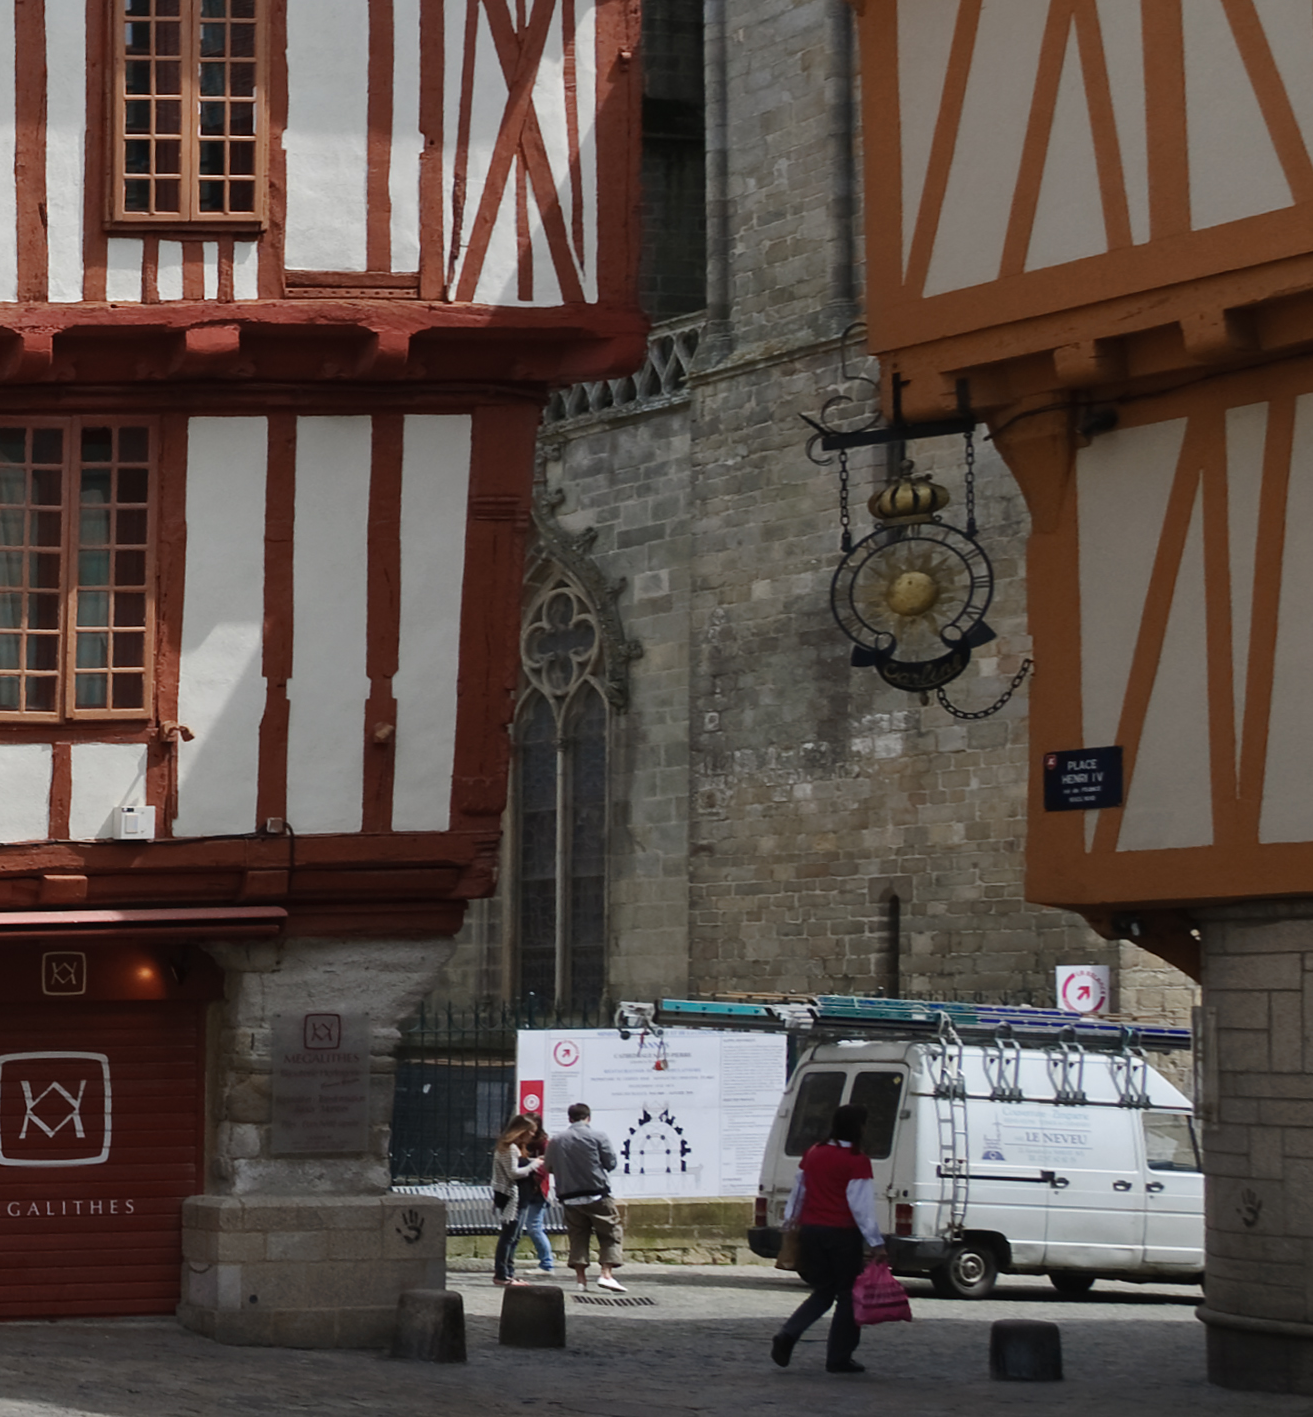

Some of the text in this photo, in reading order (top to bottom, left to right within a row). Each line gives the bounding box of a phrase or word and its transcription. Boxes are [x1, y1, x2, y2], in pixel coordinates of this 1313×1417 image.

[1066, 758, 1098, 771] PLACE
[1061, 771, 1104, 784] HENRI IV
[283, 1053, 361, 1064] MEGALITHES
[1025, 1131, 1088, 1145] LE NEVEU
